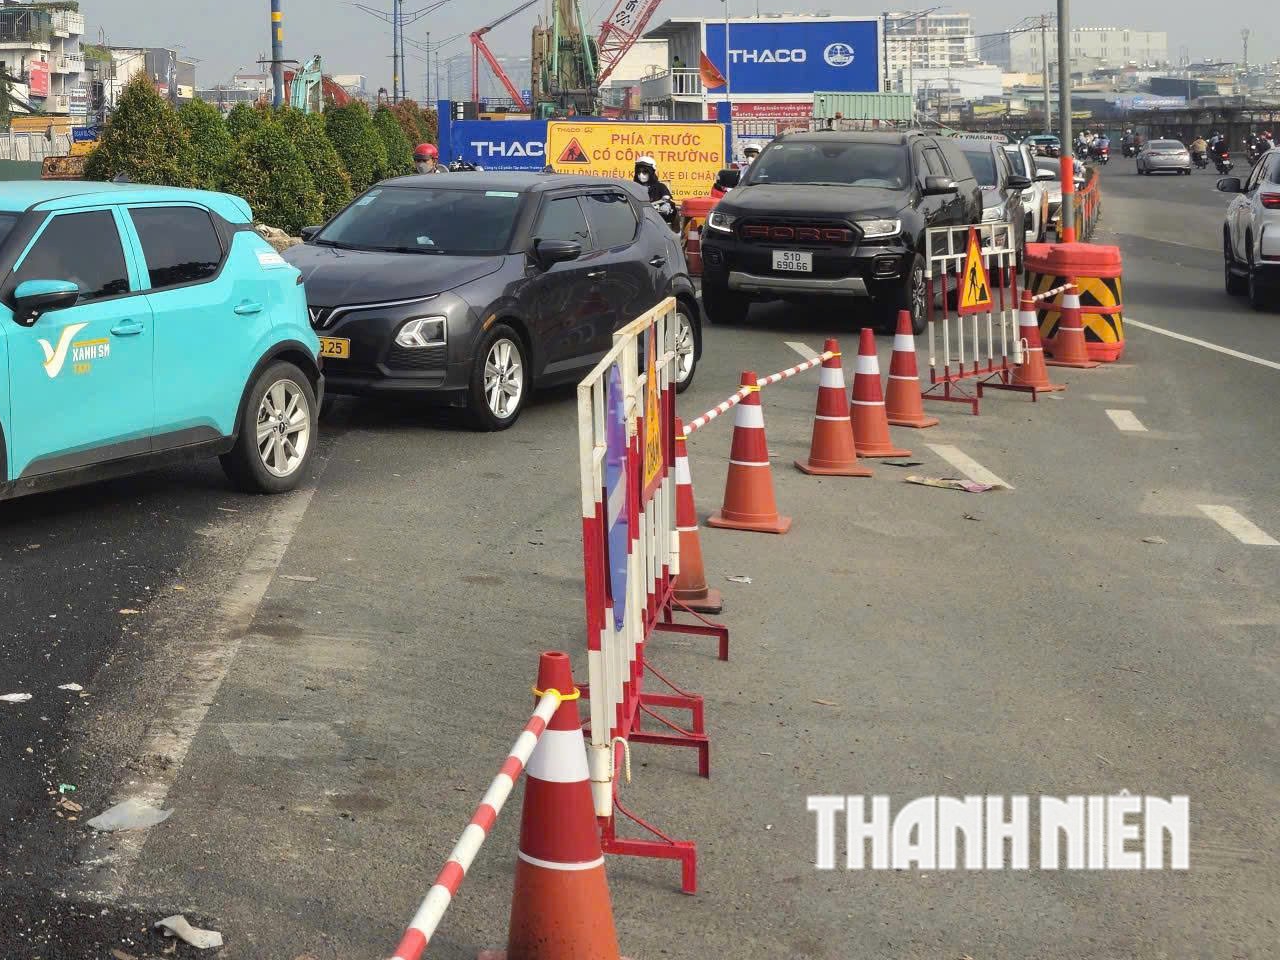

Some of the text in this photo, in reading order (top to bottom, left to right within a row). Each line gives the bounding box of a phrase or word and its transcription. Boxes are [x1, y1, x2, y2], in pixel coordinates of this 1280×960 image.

[729, 48, 807, 64] THACO
[611, 132, 701, 146] PHÍA TRƯỚC
[593, 147, 611, 161] CÓ
[658, 148, 719, 163] TRƯỜNG
[662, 171, 675, 180] XE
[783, 252, 801, 261] 51D
[776, 261, 808, 270] 690.66
[72, 343, 110, 361] XANH SM
